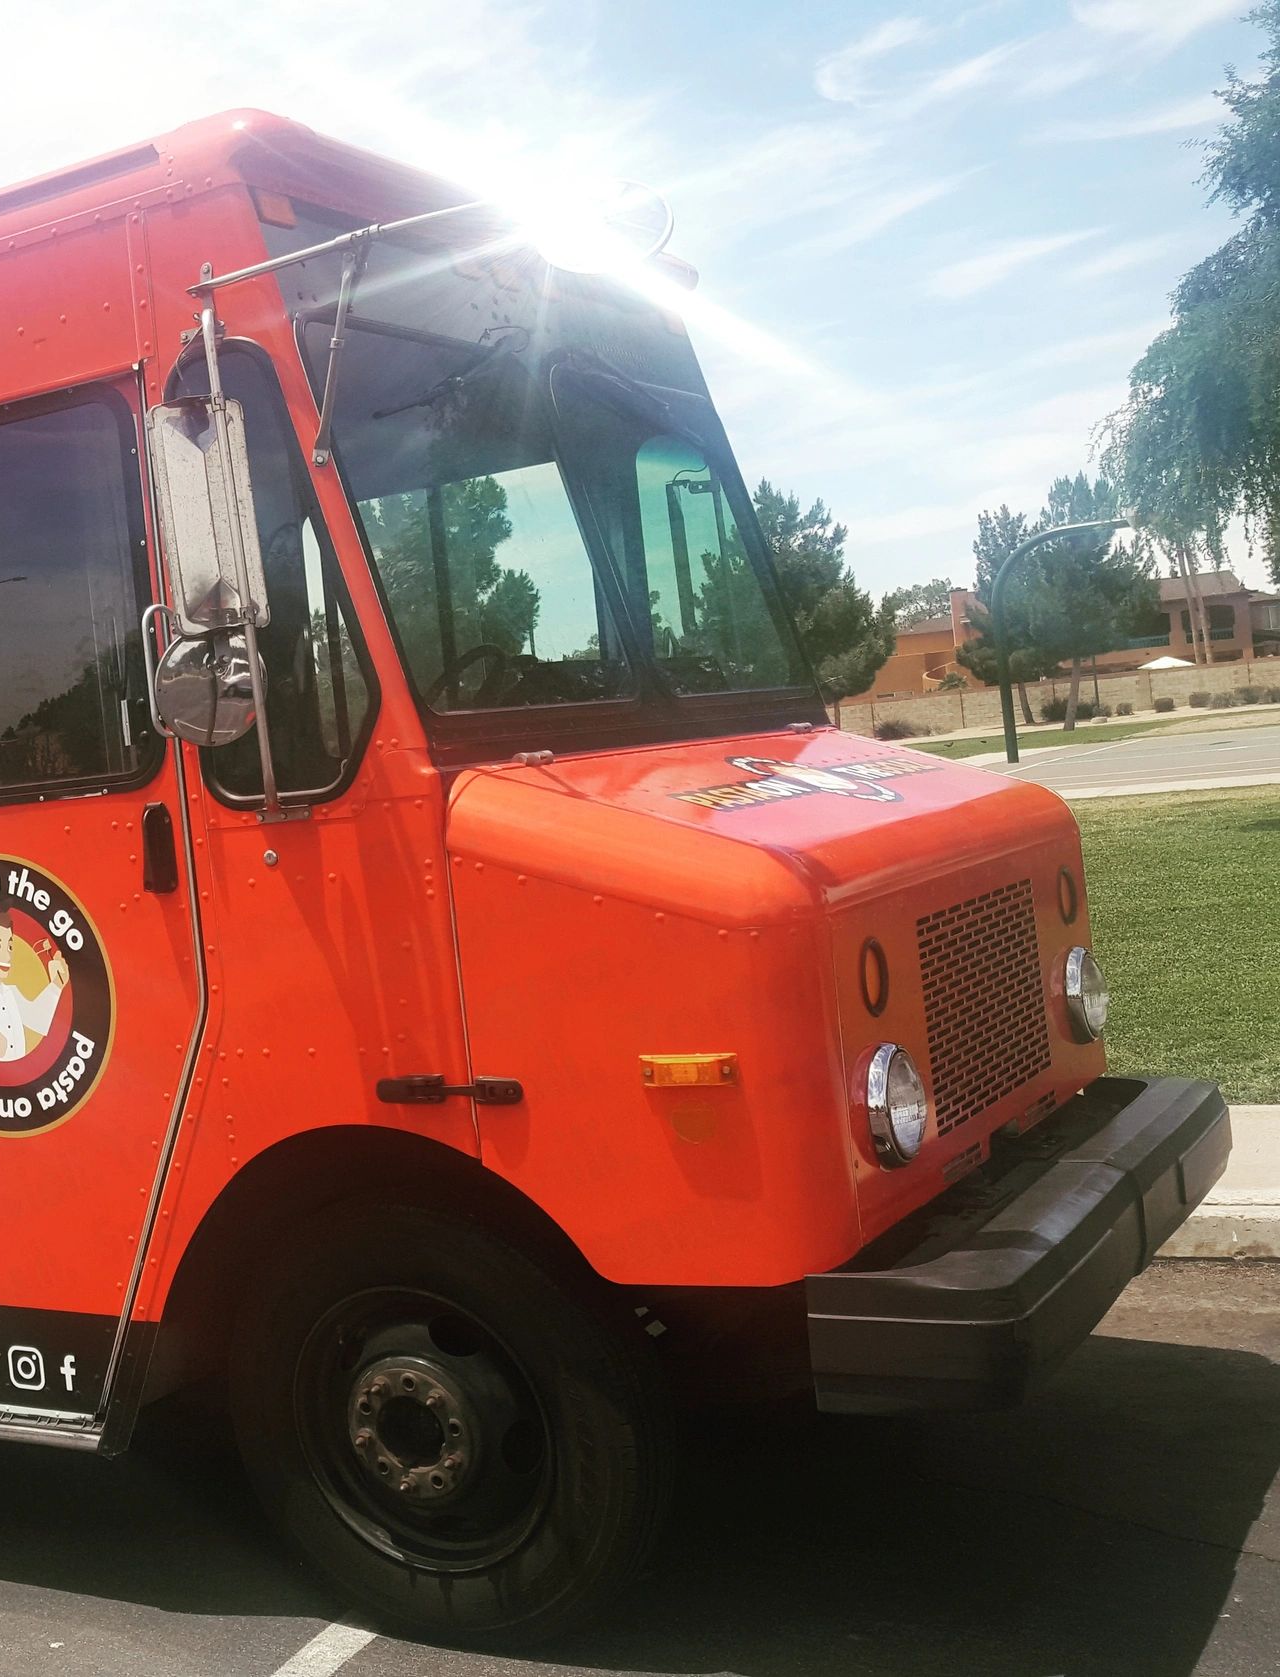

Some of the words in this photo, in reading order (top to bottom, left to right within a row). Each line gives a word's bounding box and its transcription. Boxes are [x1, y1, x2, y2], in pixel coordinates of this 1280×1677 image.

[8, 868, 51, 911] the
[48, 910, 84, 951] go
[36, 1031, 96, 1111] pasta
